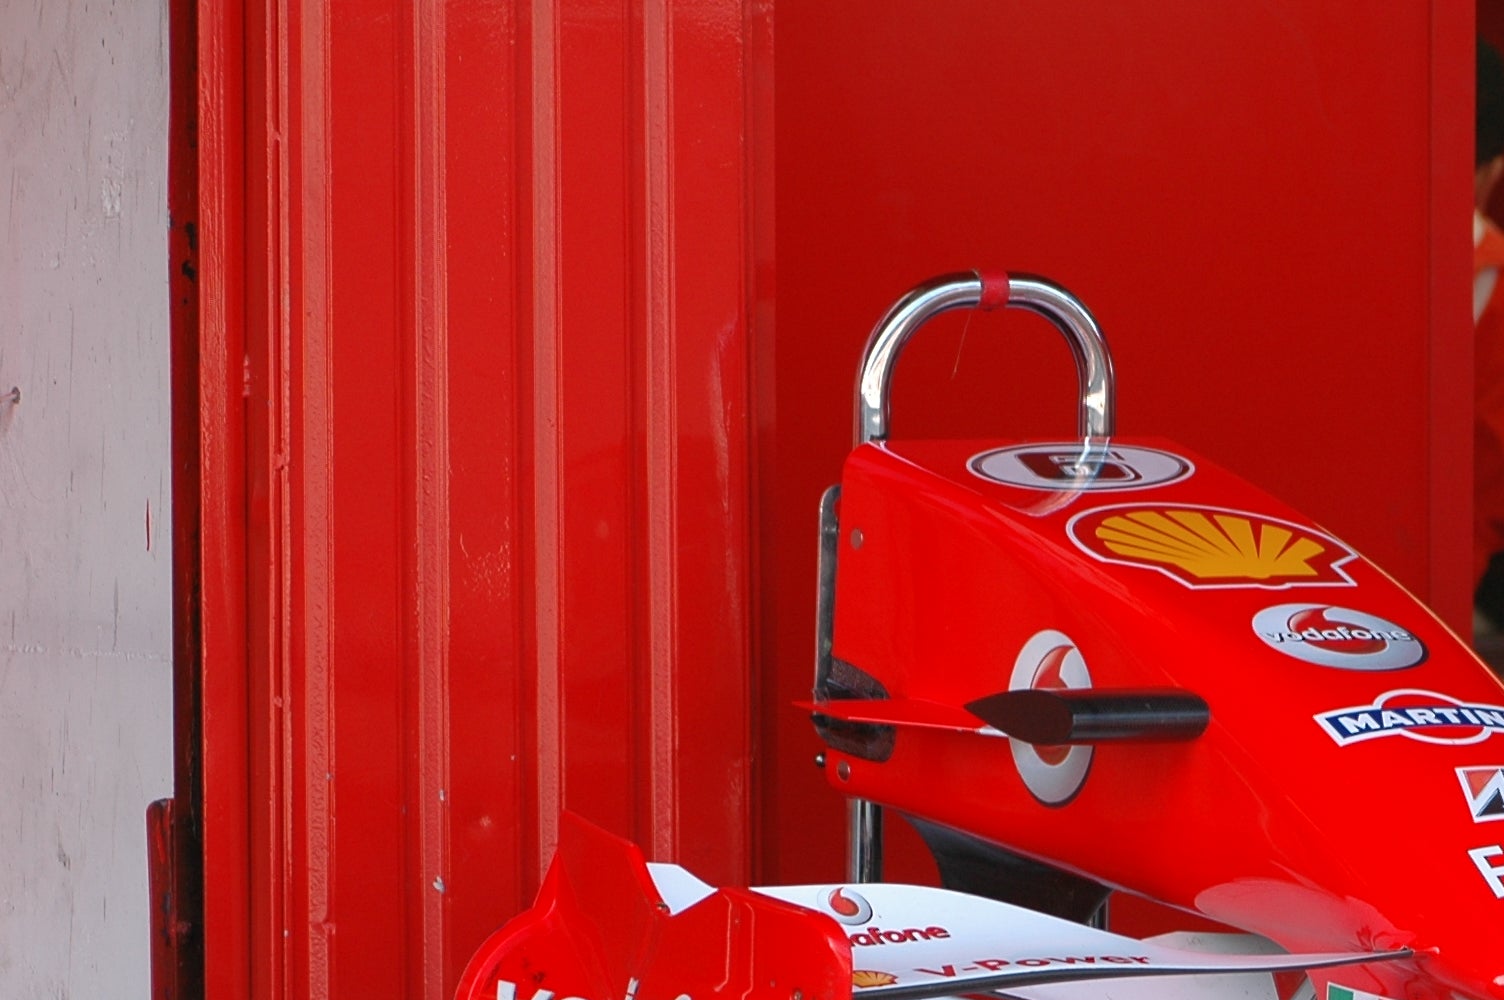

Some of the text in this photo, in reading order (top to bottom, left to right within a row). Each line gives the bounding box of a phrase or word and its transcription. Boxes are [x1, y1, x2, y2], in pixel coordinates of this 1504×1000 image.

[1264, 626, 1413, 643] vodafone
[850, 926, 951, 948] afone
[914, 955, 1150, 977] V-Power
